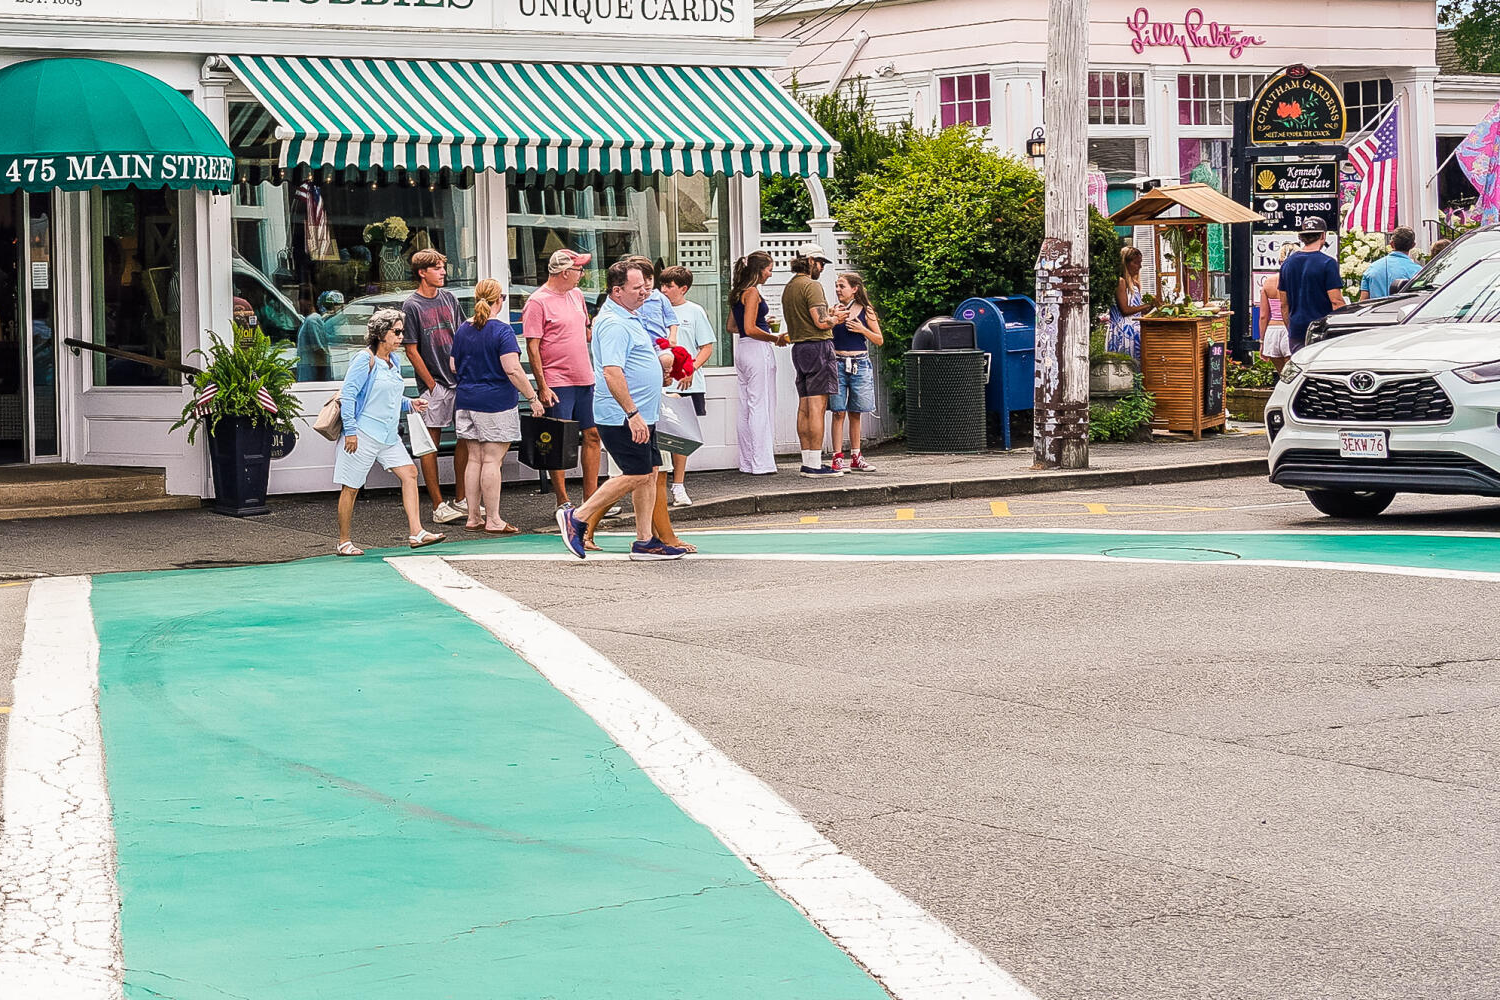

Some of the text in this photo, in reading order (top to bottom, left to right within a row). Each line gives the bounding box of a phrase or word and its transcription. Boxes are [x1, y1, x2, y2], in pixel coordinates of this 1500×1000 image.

[1127, 7, 1266, 63] Lilly Pulitzer
[1257, 80, 1340, 124] CHATHAM GARDENS
[5, 154, 234, 182] 475 MAIN STREET
[1286, 165, 1323, 179] Kennedy
[1278, 177, 1331, 191] Real Estate
[1284, 201, 1332, 215] espresso
[1341, 438, 1384, 452] 3EKW 76
